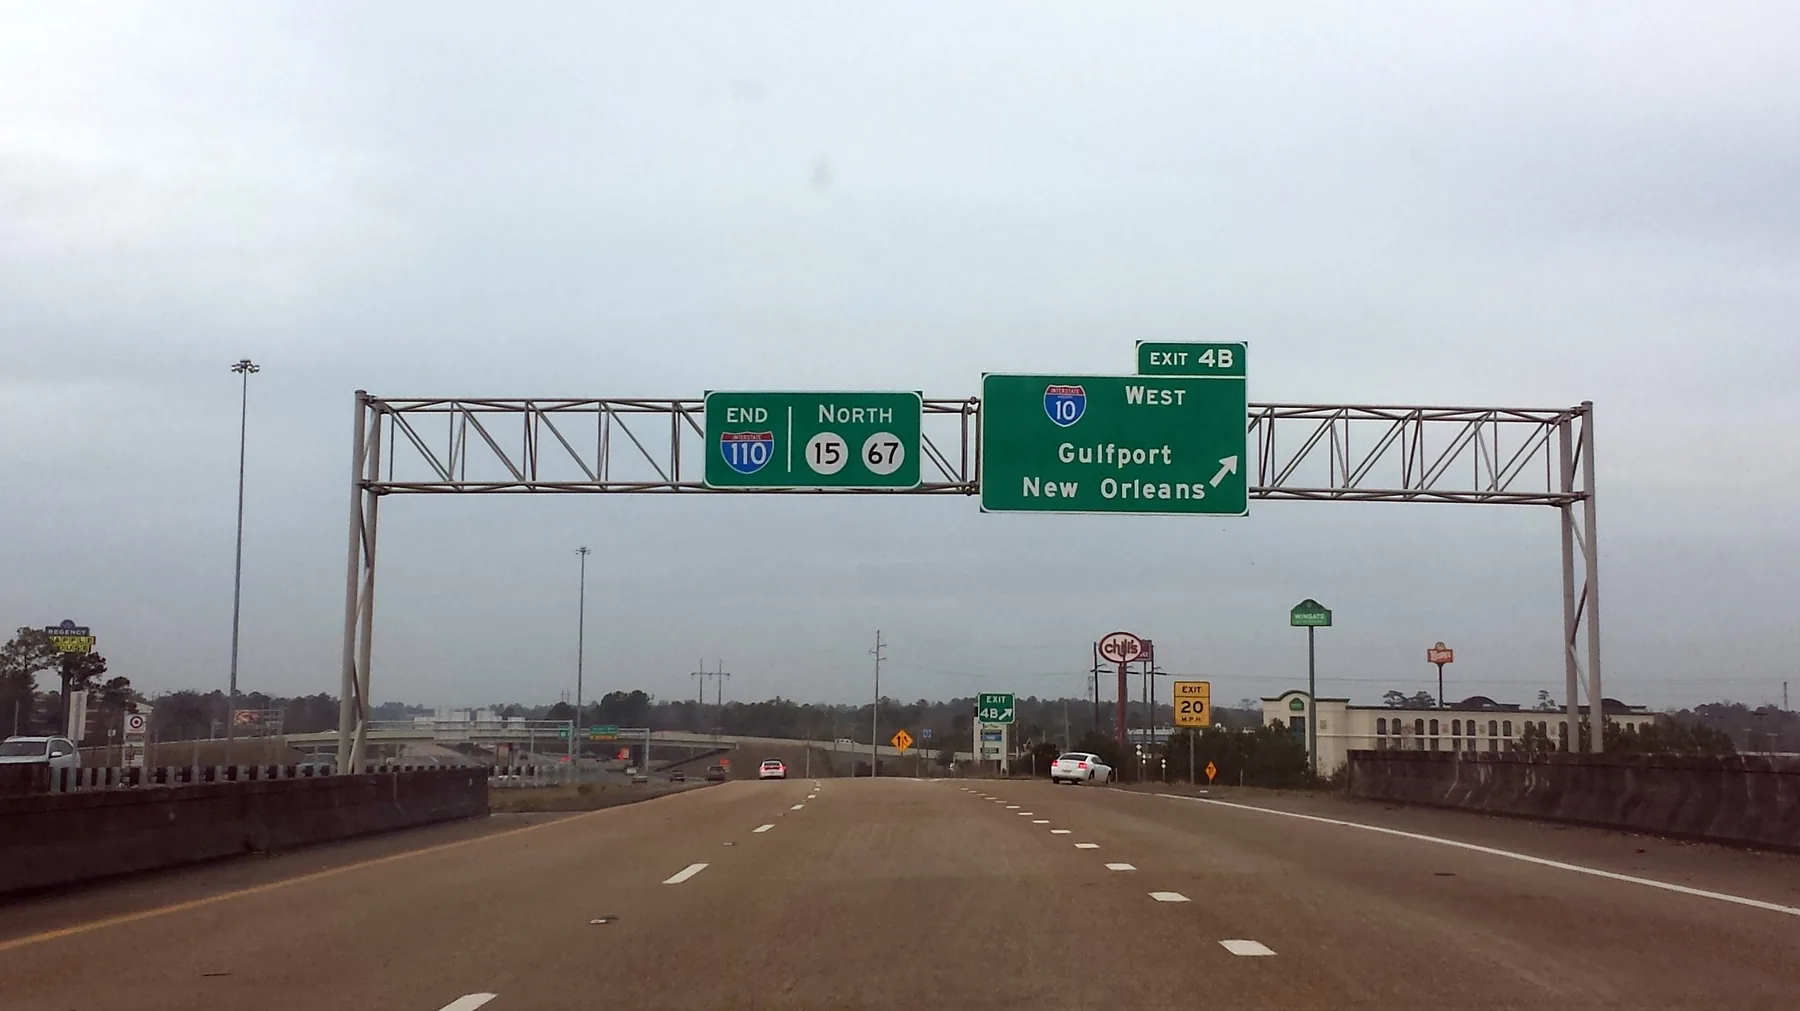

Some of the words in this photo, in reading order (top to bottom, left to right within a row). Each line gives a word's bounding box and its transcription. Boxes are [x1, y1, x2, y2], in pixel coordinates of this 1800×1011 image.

[1150, 352, 1188, 366] EXIT
[1198, 349, 1233, 368] 4B
[1050, 387, 1080, 395] INTERSTATE
[1125, 386, 1186, 405] WEST
[727, 407, 768, 423] END
[819, 404, 893, 424] NORTH
[1055, 400, 1076, 421] 10
[732, 433, 762, 441] INTERSTATE
[731, 442, 767, 465] 110
[815, 442, 840, 465] 15
[868, 442, 899, 465] 67
[1058, 443, 1172, 468] Gulfport
[1023, 477, 1078, 498] New
[1100, 479, 1205, 500] Orleans
[1182, 686, 1202, 694] EXIT
[980, 708, 998, 719] 4B
[1181, 700, 1203, 714] 20
